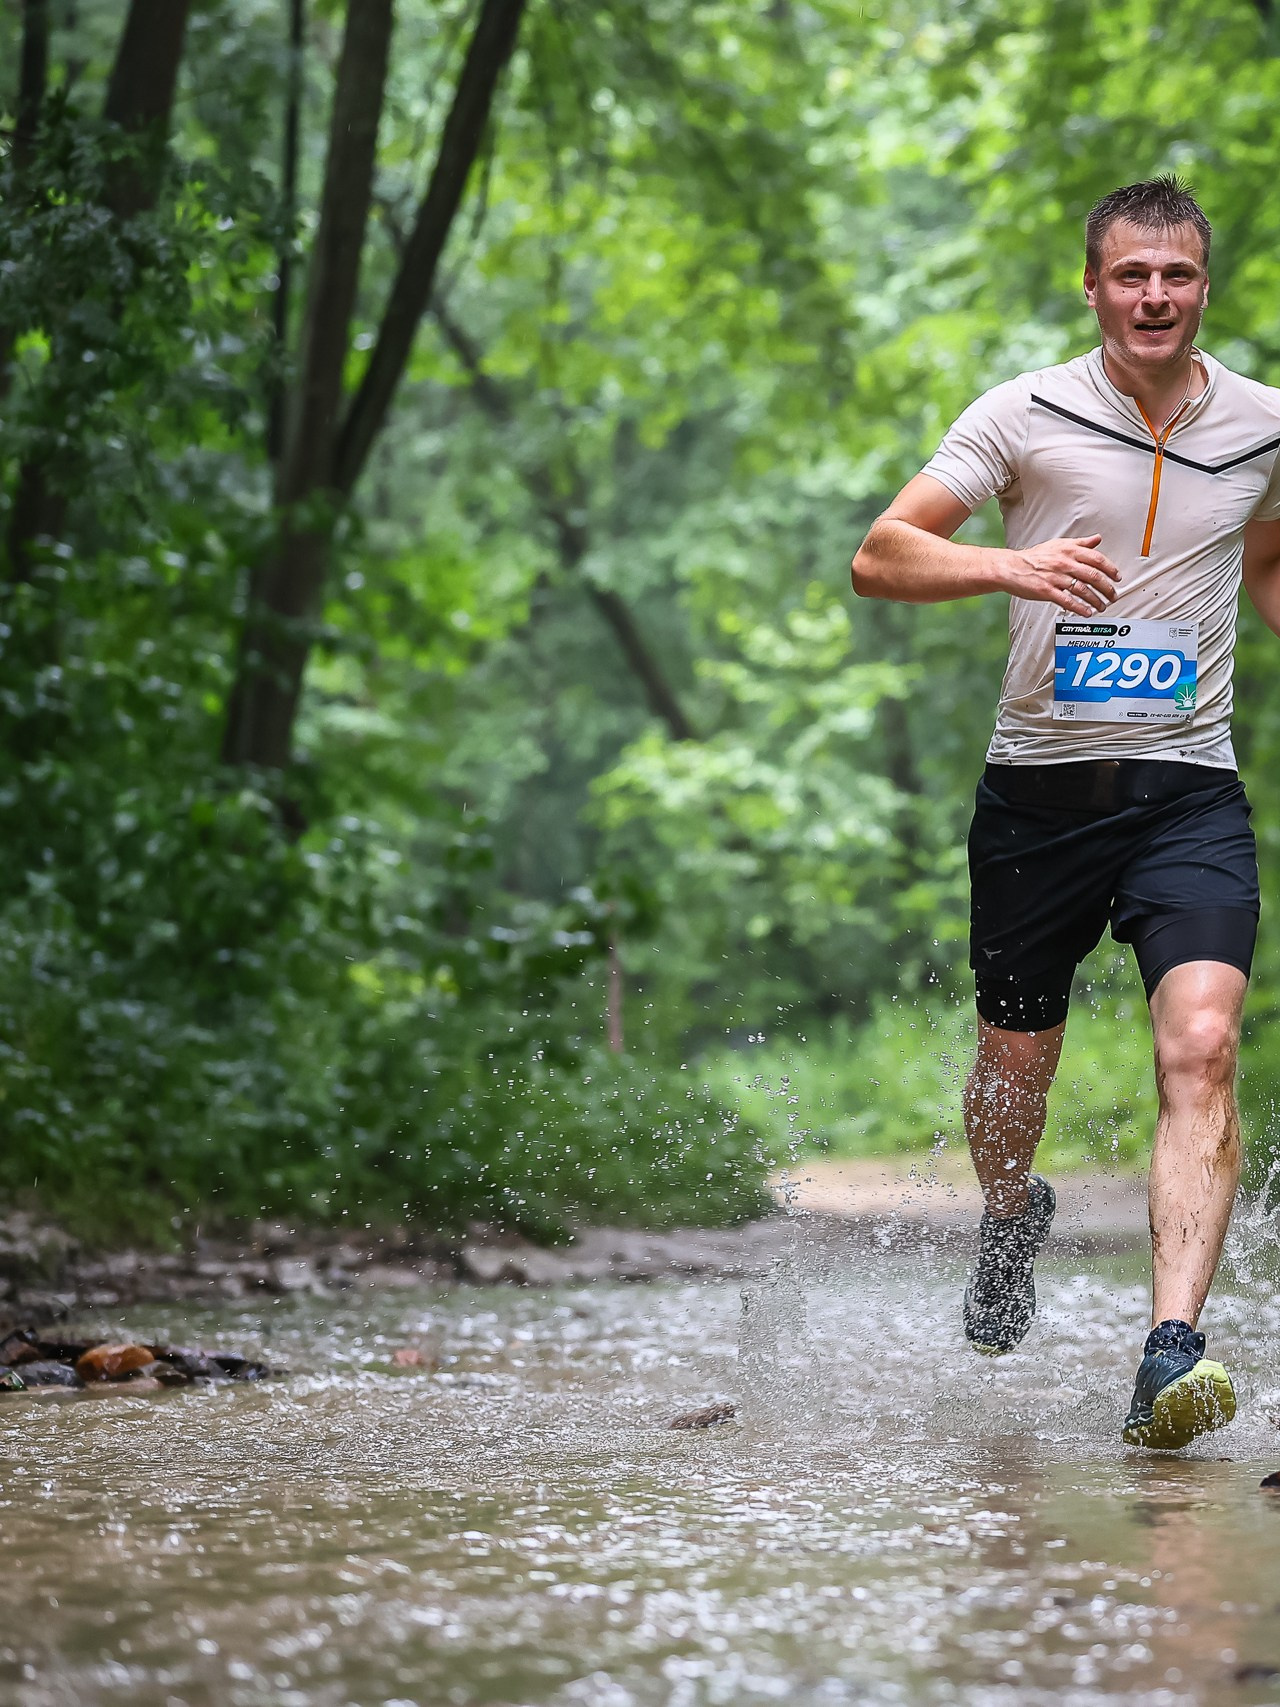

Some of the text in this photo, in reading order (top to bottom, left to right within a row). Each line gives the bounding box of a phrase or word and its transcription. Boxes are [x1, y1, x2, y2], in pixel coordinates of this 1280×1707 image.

[1121, 627, 1128, 635] 3
[1067, 640, 1115, 648] MEDIUM 10
[1071, 651, 1182, 691] 1290
